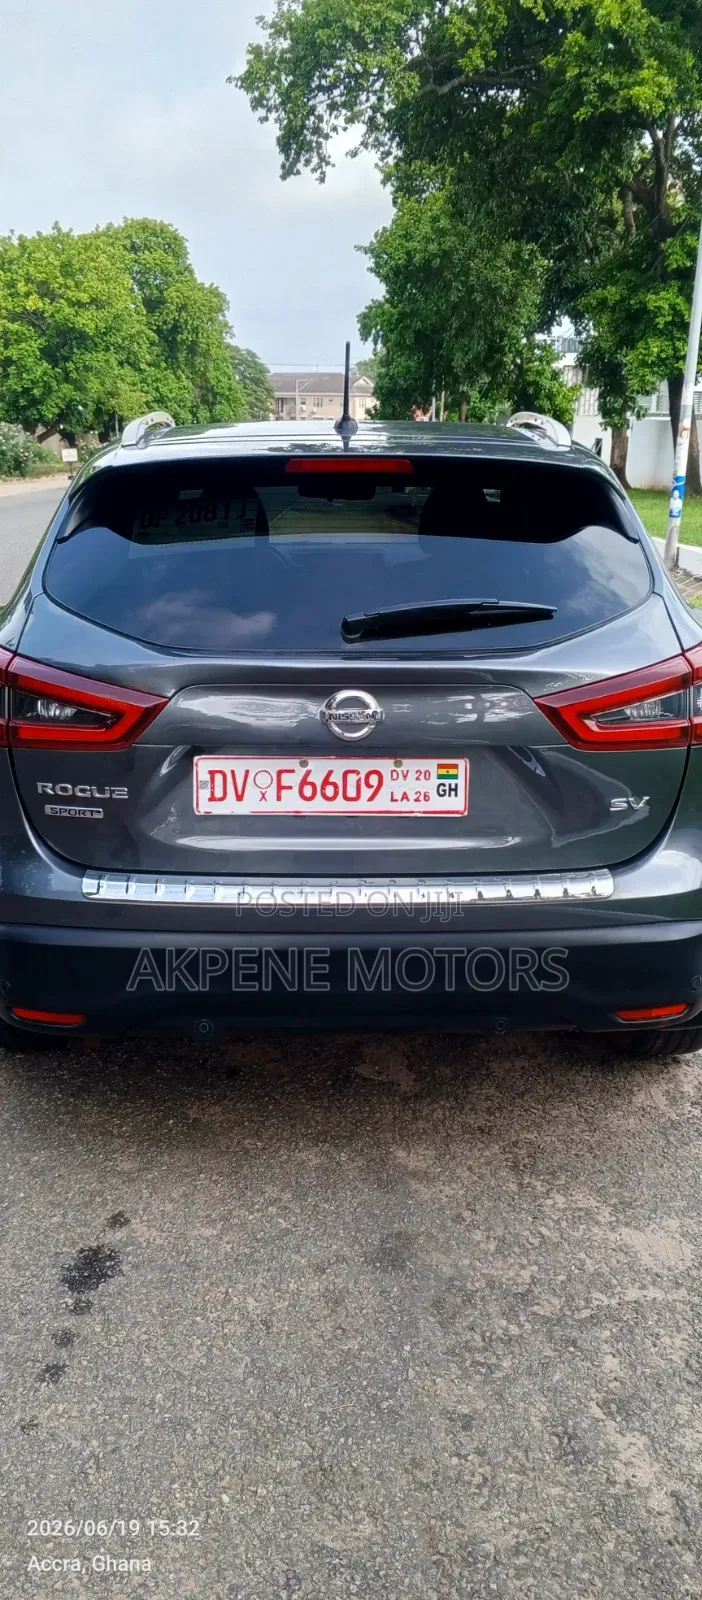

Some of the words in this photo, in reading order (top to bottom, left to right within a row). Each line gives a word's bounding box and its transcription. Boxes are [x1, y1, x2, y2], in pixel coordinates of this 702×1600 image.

[329, 710, 378, 721] NISSAN
[390, 769, 410, 781] DV
[415, 769, 432, 781] 20
[36, 782, 129, 799] ROGUE
[207, 769, 250, 802] DV
[276, 769, 384, 802] F6609
[436, 782, 459, 798] GH
[390, 791, 409, 802] LA
[413, 791, 431, 802] 26
[609, 796, 650, 811] SV
[49, 806, 101, 817] SPORT
